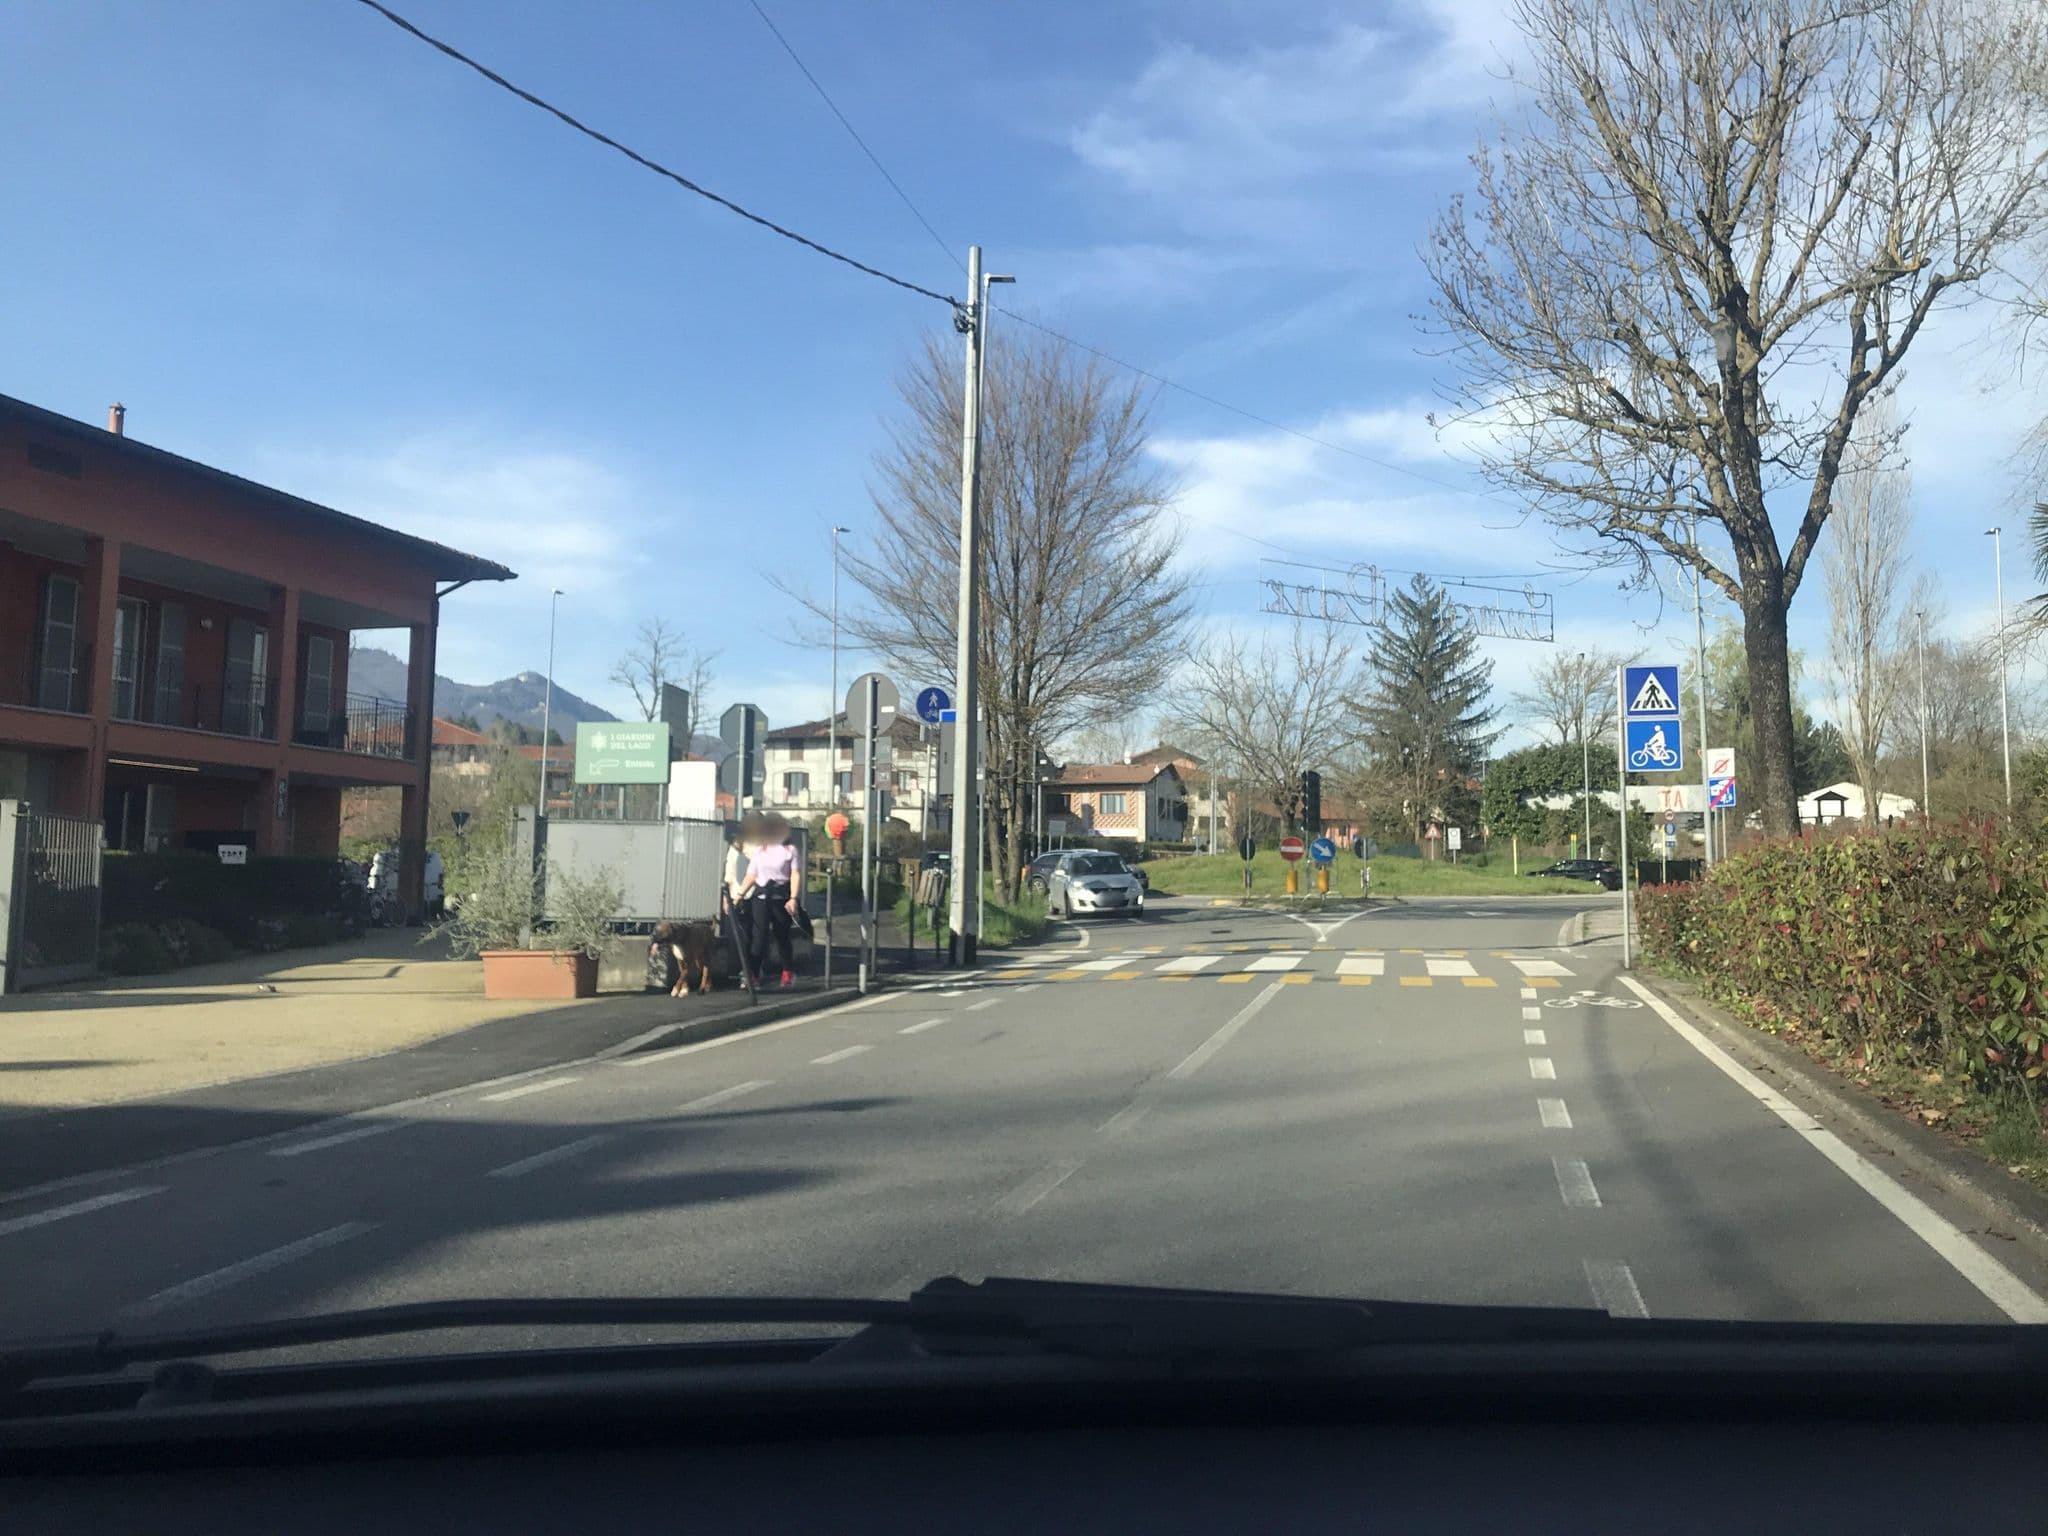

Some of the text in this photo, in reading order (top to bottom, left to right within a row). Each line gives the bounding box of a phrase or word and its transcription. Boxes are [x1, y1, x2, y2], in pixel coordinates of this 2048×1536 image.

[617, 733, 655, 741] GIARDINI
[610, 742, 651, 750] DEL LAGO
